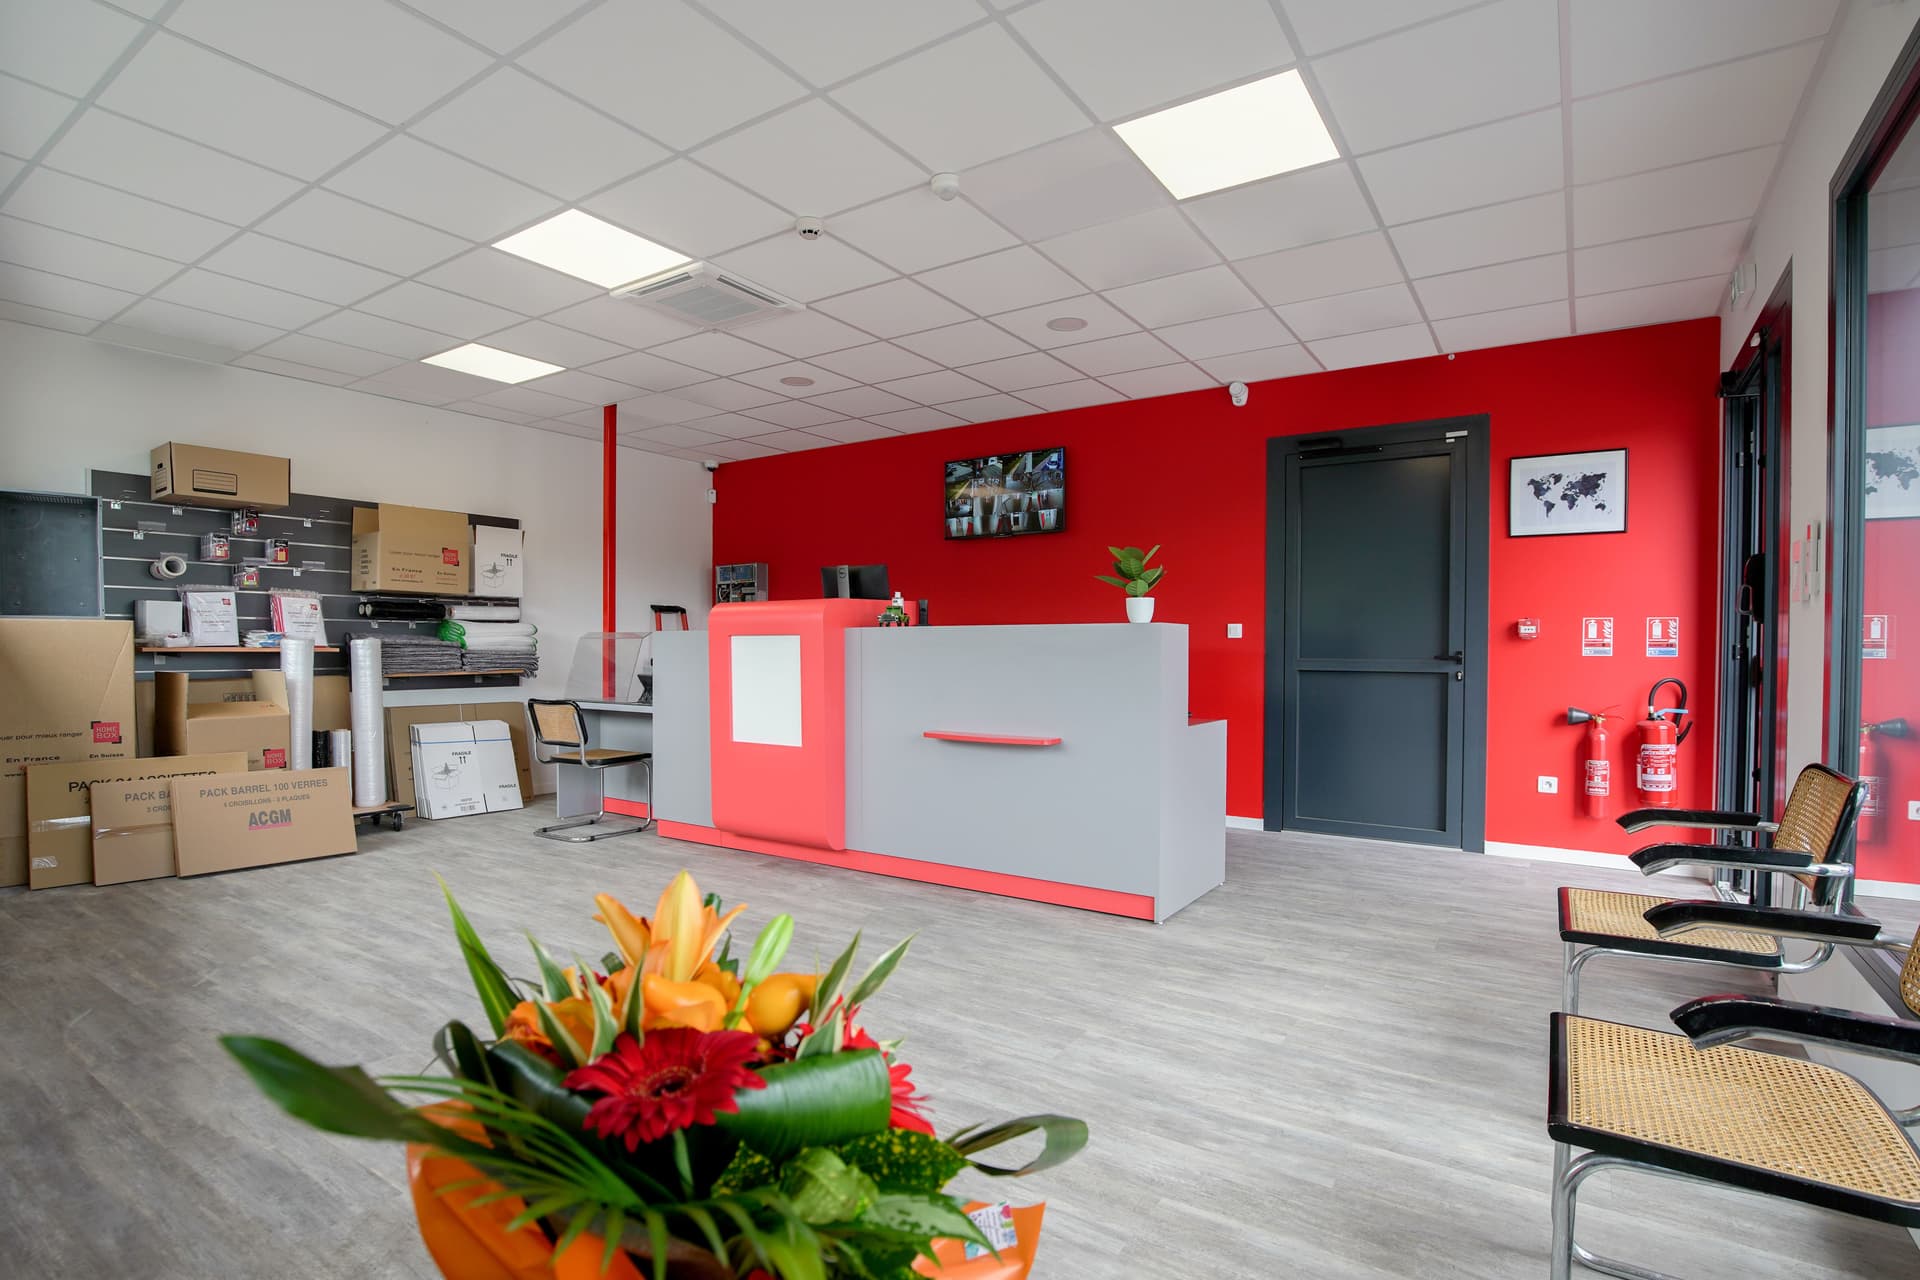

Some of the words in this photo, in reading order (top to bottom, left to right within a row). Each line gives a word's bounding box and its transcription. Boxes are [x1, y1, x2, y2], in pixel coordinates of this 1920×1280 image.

[124, 790, 155, 802] PACK
[199, 787, 228, 798] PACK
[231, 784, 271, 796] BARREL
[274, 782, 289, 791] 100
[291, 779, 328, 789] VERRES
[248, 808, 292, 827] ACGM
